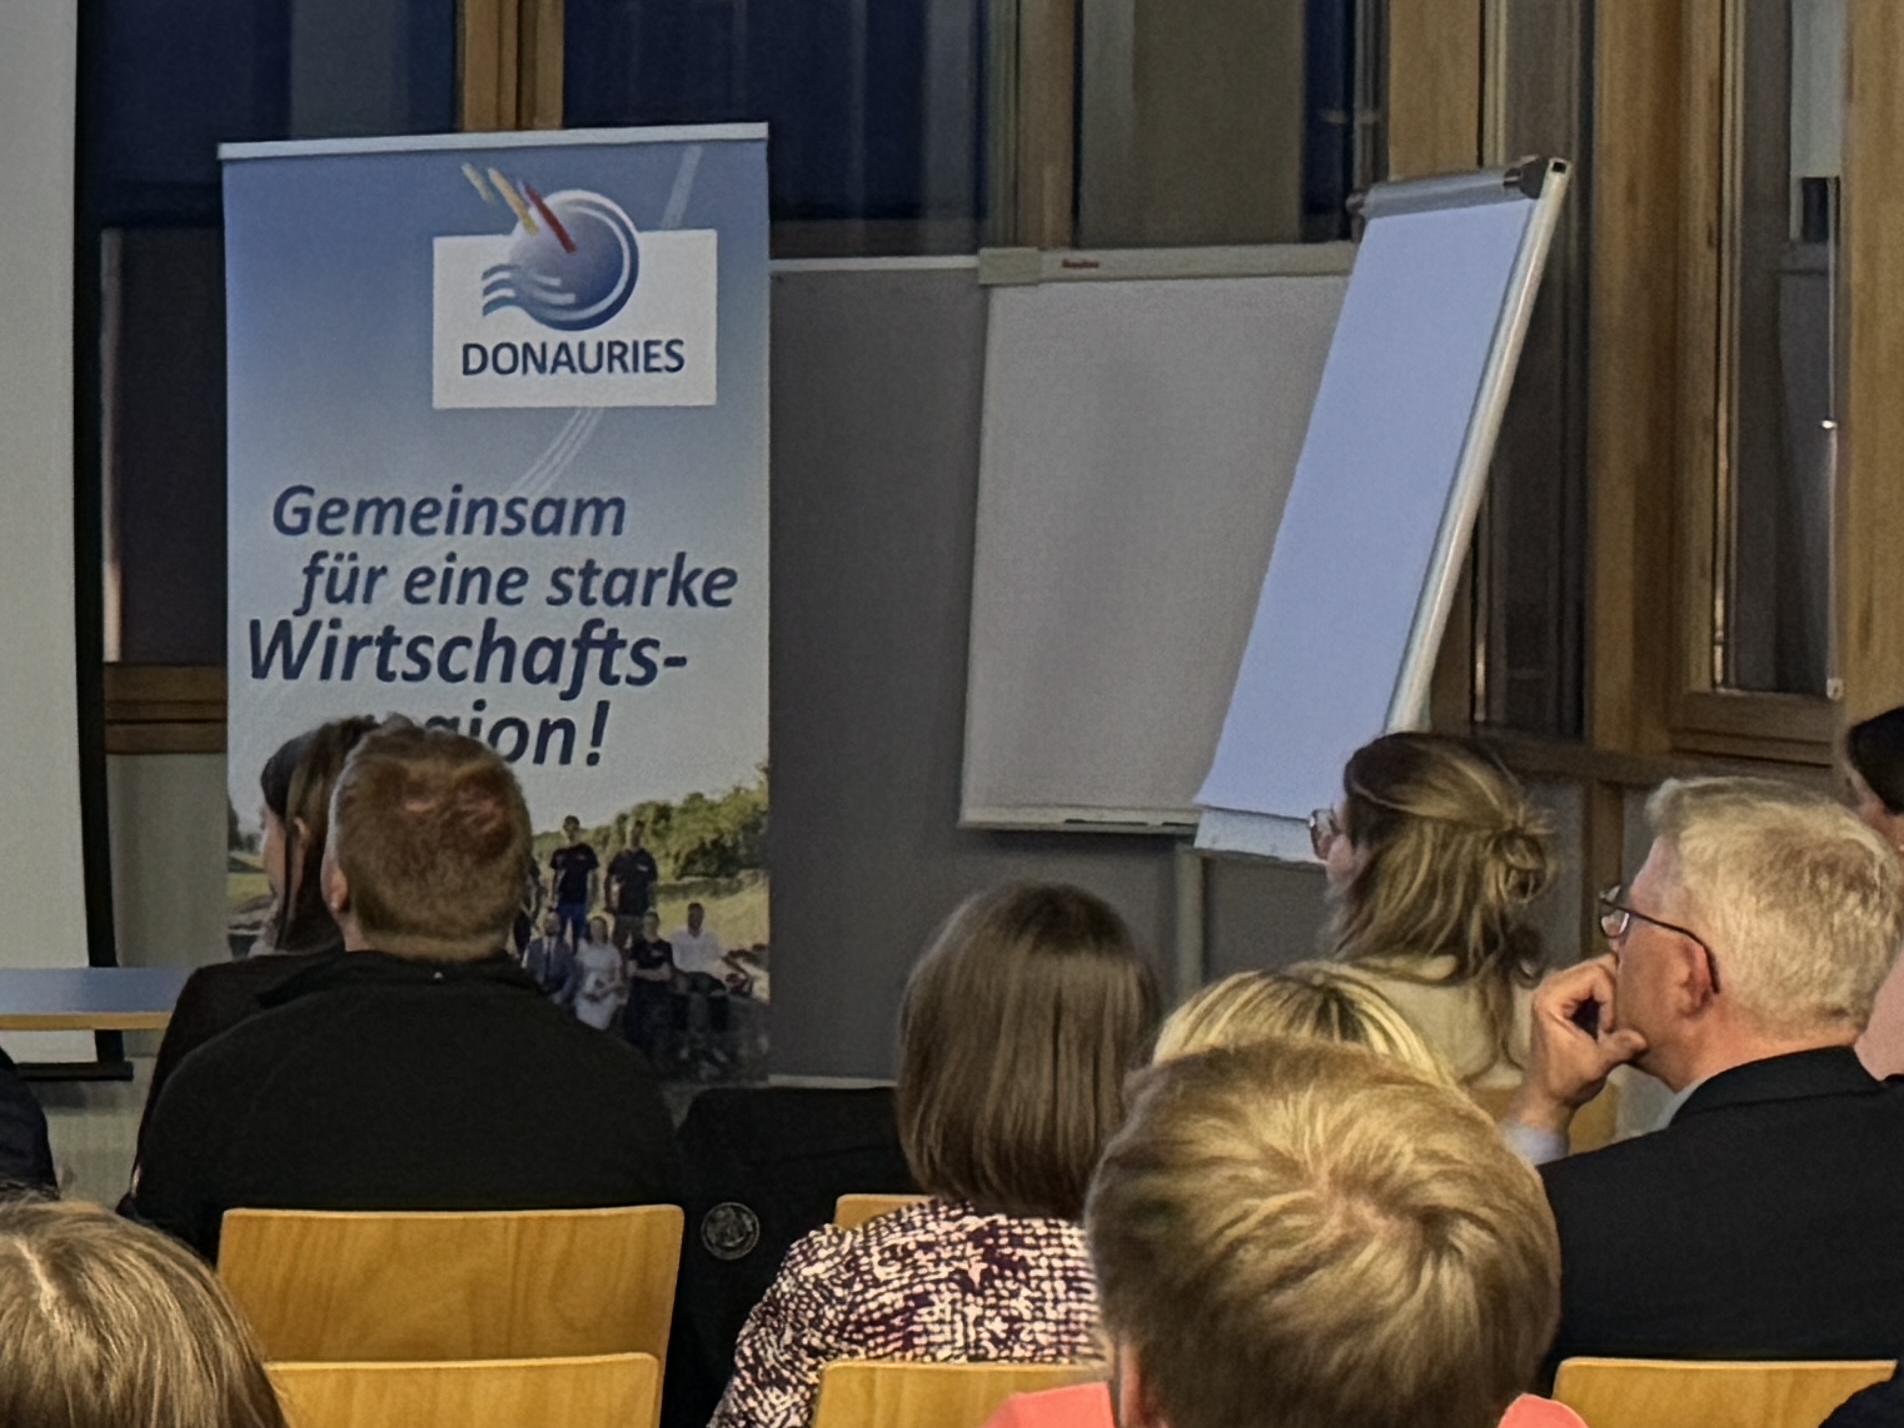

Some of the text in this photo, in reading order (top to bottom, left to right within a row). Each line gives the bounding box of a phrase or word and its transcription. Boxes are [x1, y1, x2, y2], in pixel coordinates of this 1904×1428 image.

[461, 338, 686, 376] DONAURIES
[272, 484, 626, 537] Gemeinsam
[292, 550, 739, 617] für eine starke
[248, 617, 688, 702] Wirtschafts-
